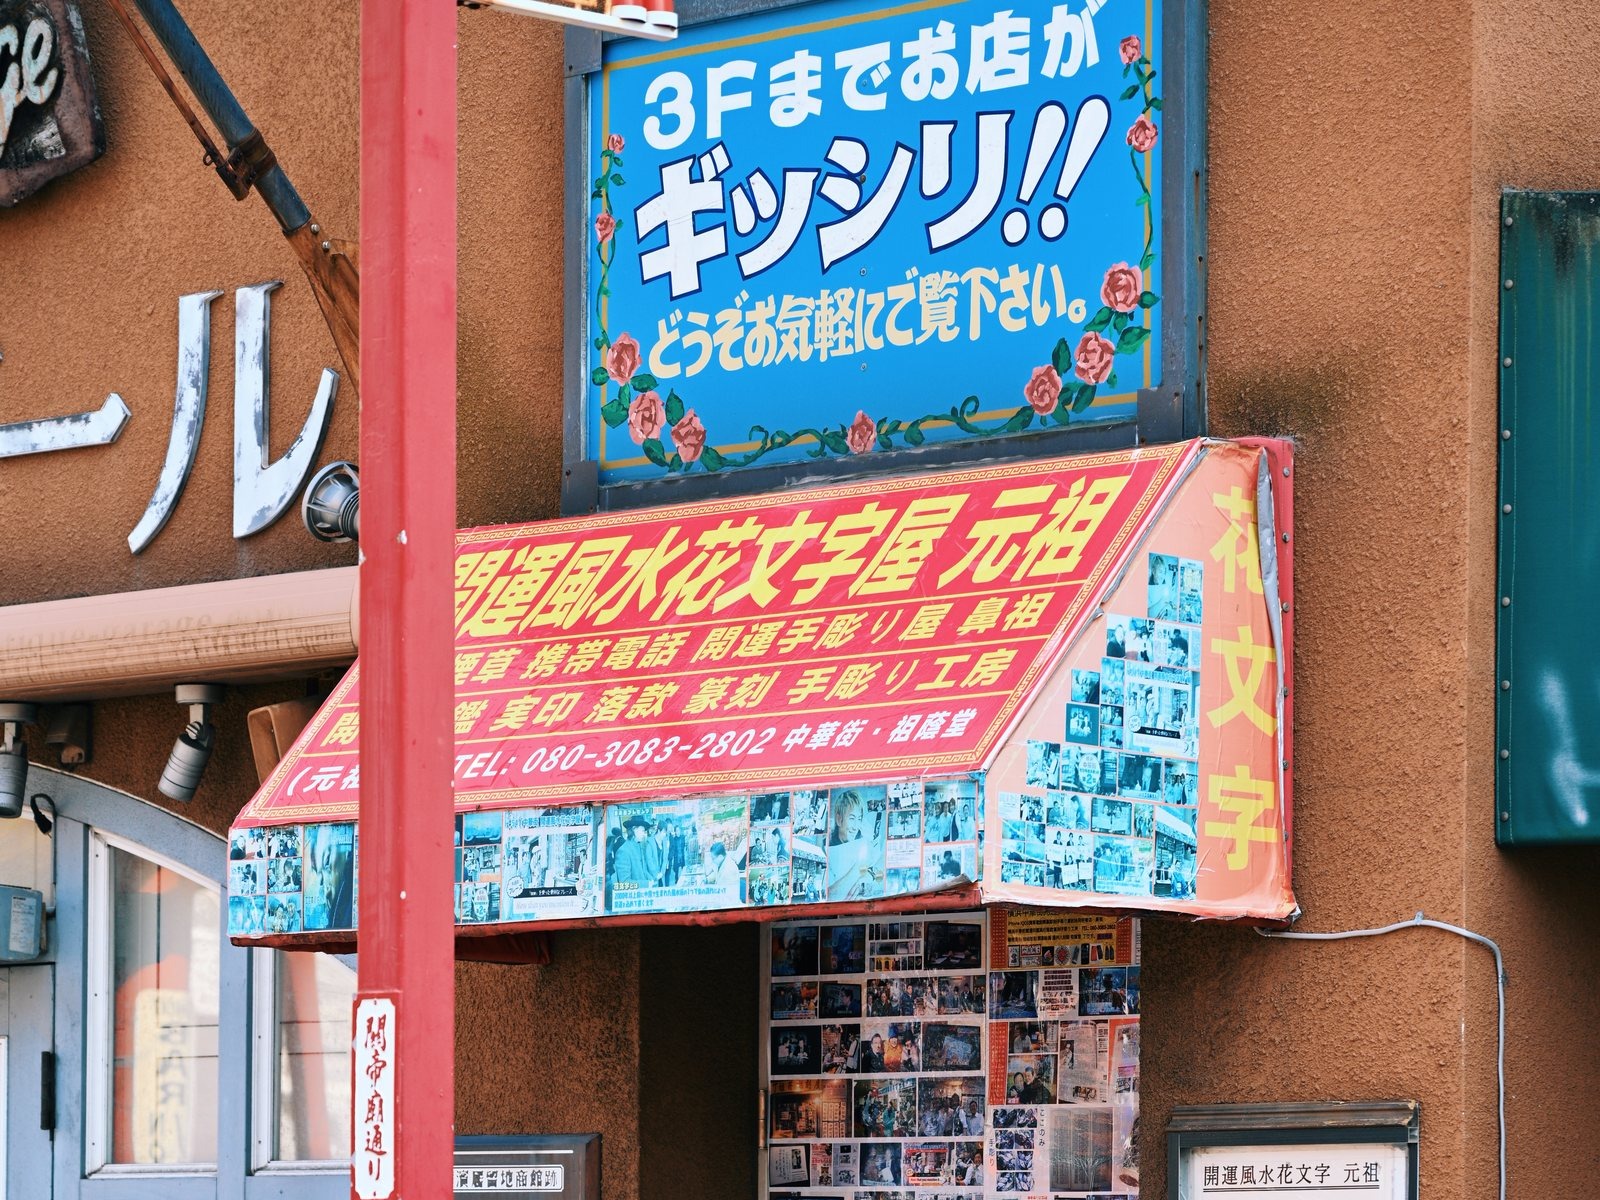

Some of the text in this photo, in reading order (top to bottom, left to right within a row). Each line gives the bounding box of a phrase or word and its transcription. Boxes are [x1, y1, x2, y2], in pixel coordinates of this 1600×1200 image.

[643, 0, 1102, 150] 3Fまでお店が
[648, 263, 1087, 379] どうぞお気軽にご覧下さい。
[455, 474, 1131, 639] 開運風水花文字屋 元祖
[521, 631, 687, 680] 携帯電話
[689, 603, 942, 665] 開運手彫り屋
[957, 592, 1053, 636] 鼻祖
[1204, 485, 1278, 870] 花文字
[495, 691, 581, 732] 実印
[588, 682, 681, 722] 落款
[683, 670, 776, 715] 篆刻
[787, 648, 1019, 700] 手彫り工房
[455, 756, 516, 782] TEL:
[522, 726, 778, 775] 080-3083-2802
[1204, 1162, 1380, 1187] 開運風水花文字 元祖
